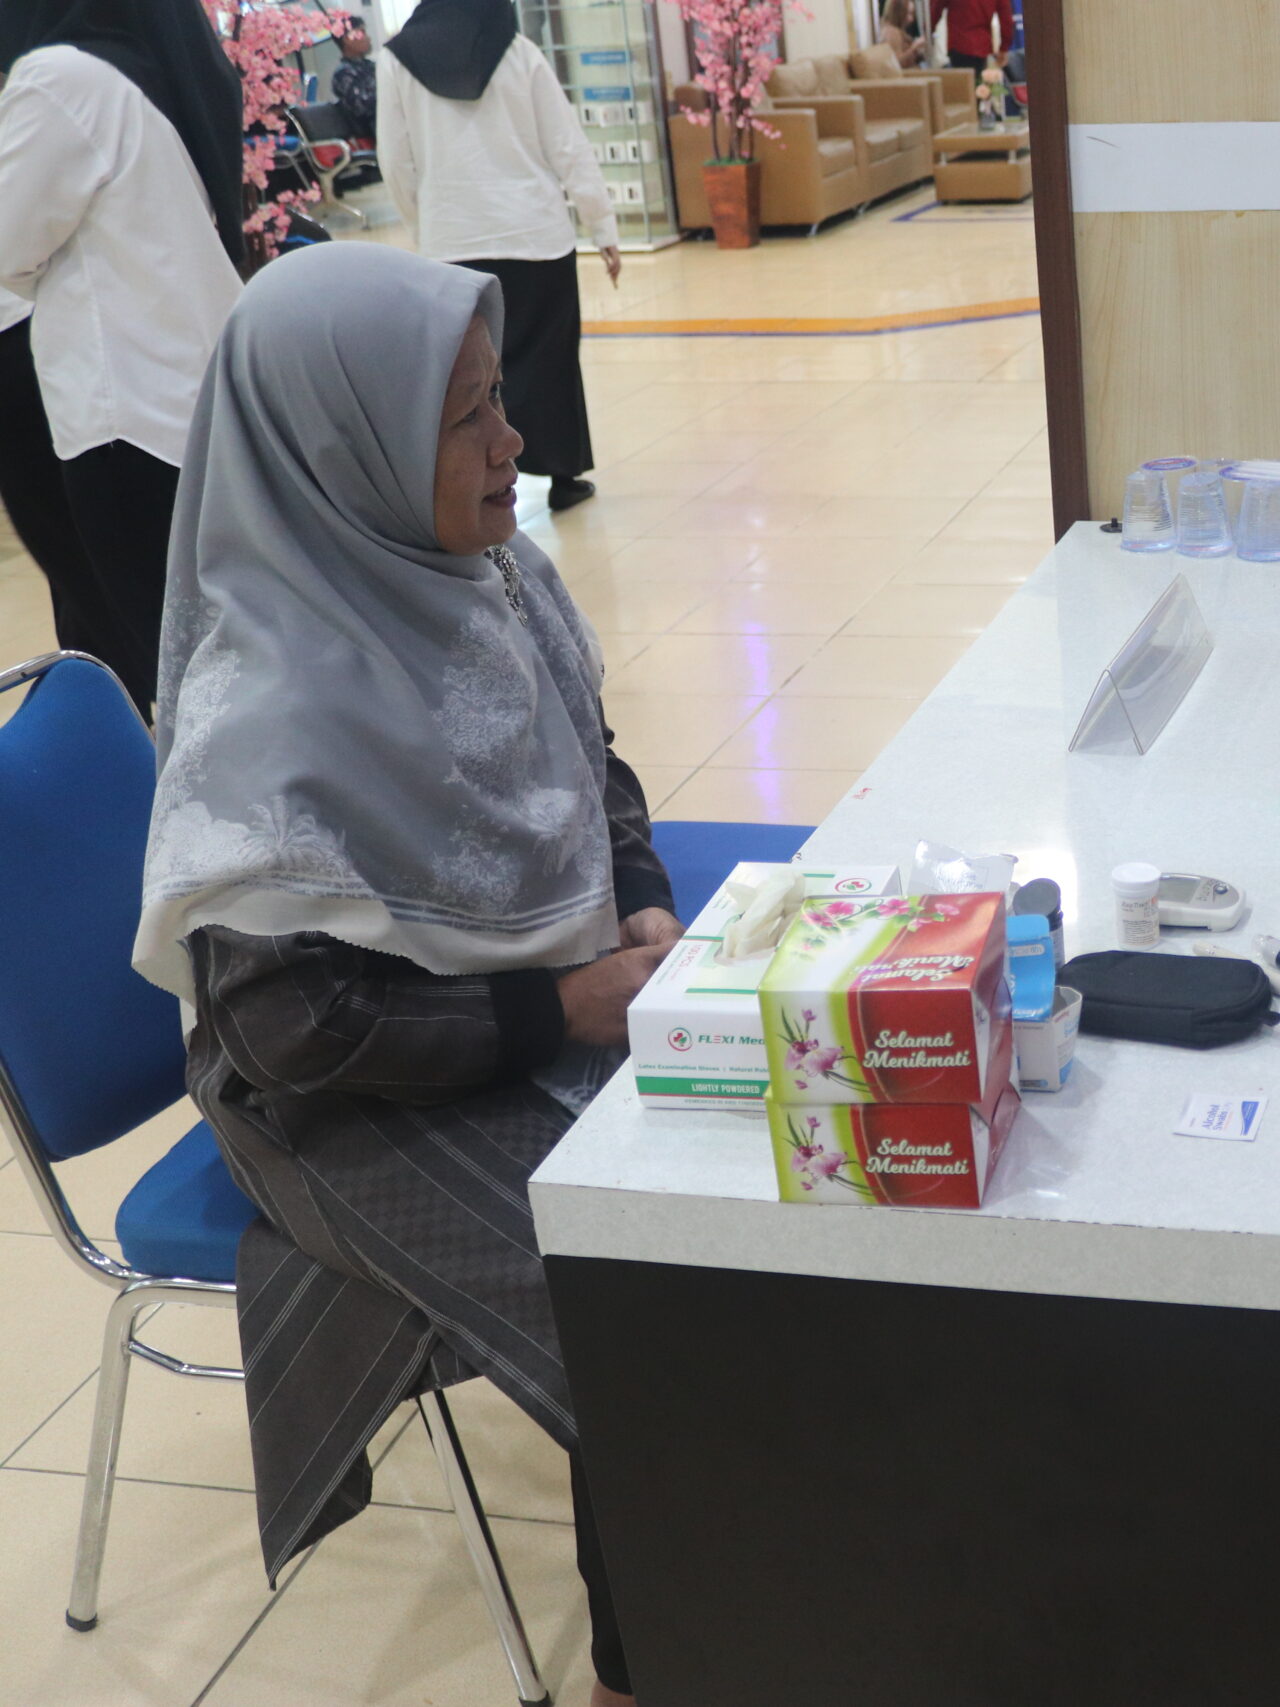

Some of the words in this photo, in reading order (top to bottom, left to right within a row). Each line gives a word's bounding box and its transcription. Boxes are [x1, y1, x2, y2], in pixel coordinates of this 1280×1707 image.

[697, 1034, 735, 1045] FLEXI
[874, 1030, 954, 1048] Selamat
[862, 1050, 971, 1068] Menikmati
[691, 1083, 719, 1093] LIGHTLY
[721, 1084, 761, 1094] POWDERED
[877, 1138, 953, 1156] Selamat
[866, 1156, 970, 1175] Menikmati
